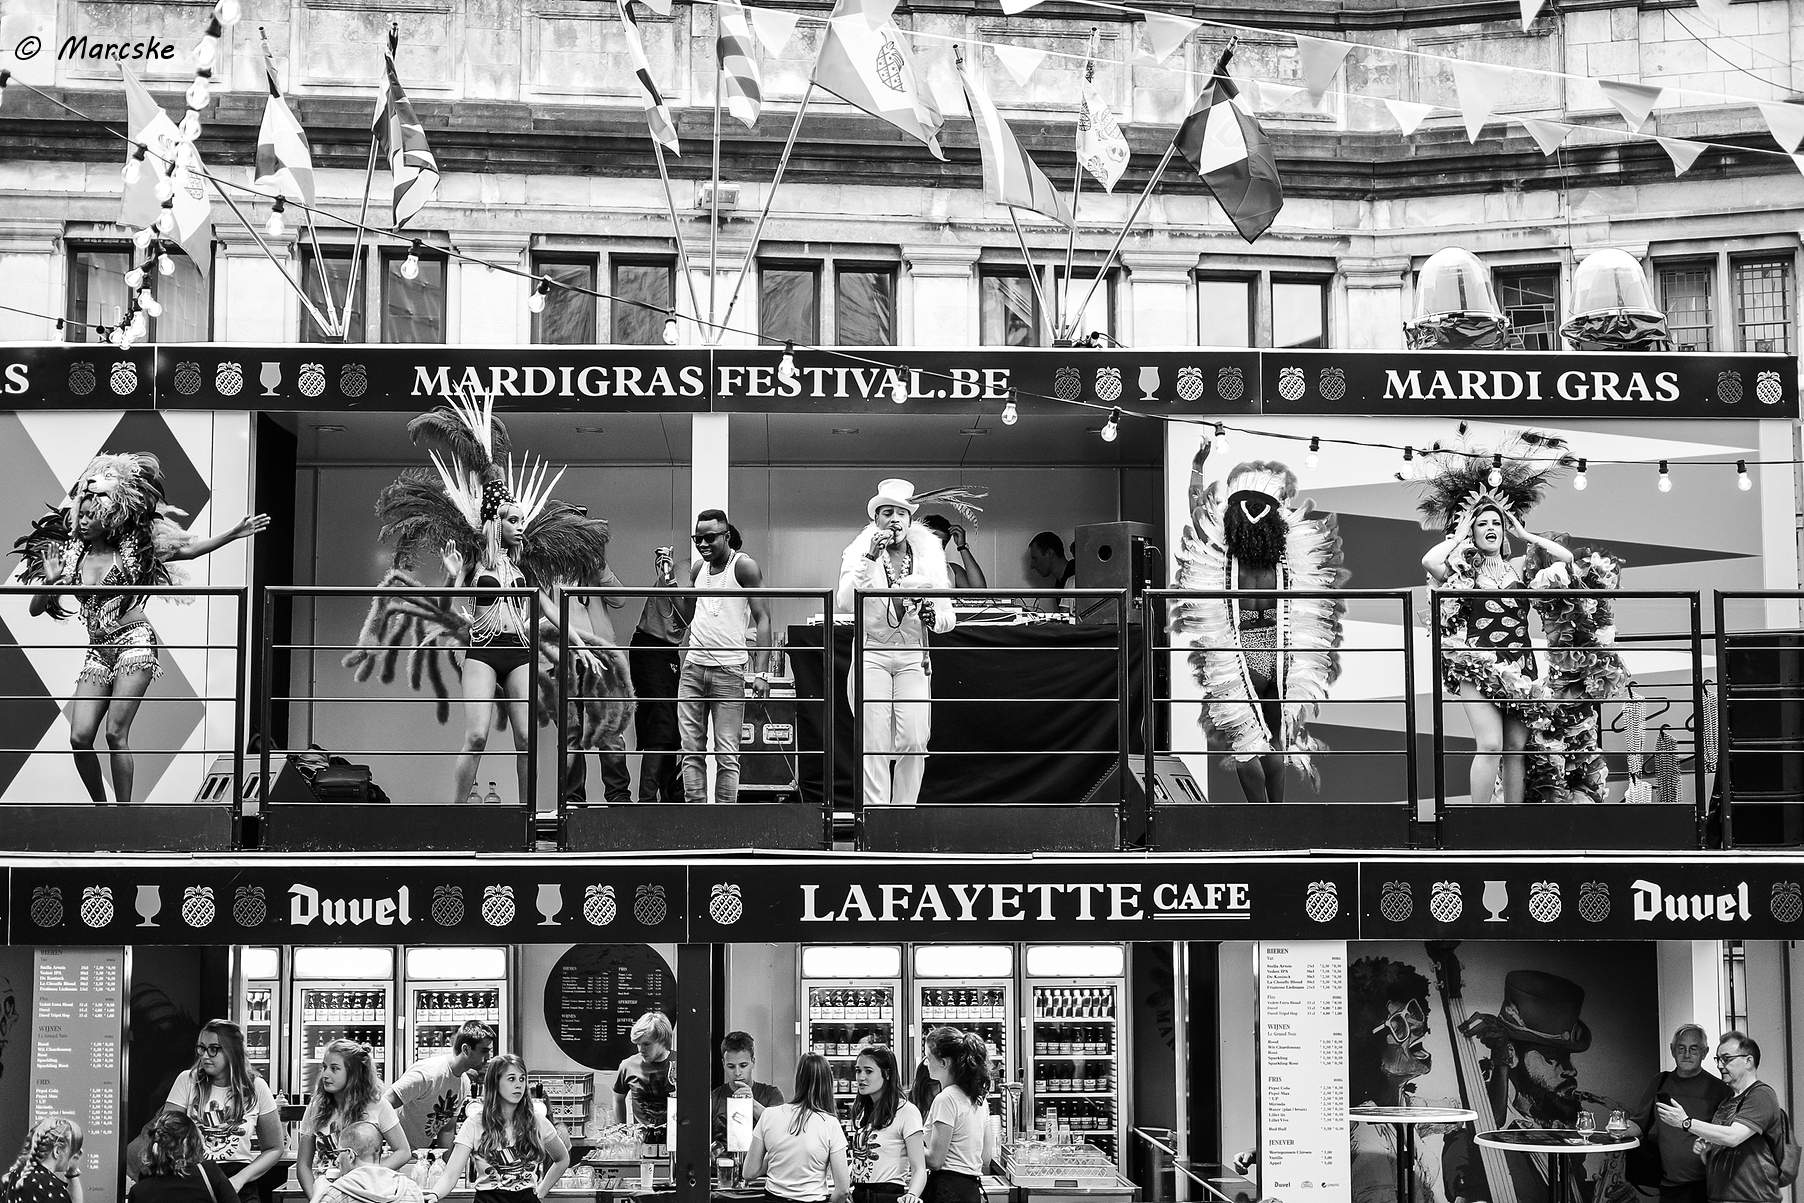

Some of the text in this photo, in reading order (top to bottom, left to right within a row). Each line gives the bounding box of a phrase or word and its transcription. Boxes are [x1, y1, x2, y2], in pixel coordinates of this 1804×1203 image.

[0, 363, 30, 394] S
[411, 366, 1011, 399] MARDIGRAS FESTIVAL.BE
[1383, 369, 1680, 401] MARDI GRAS
[287, 884, 413, 926] Duvel
[799, 882, 1251, 921] LAFAYETTE CAFE
[1630, 879, 1752, 921] Duvel
